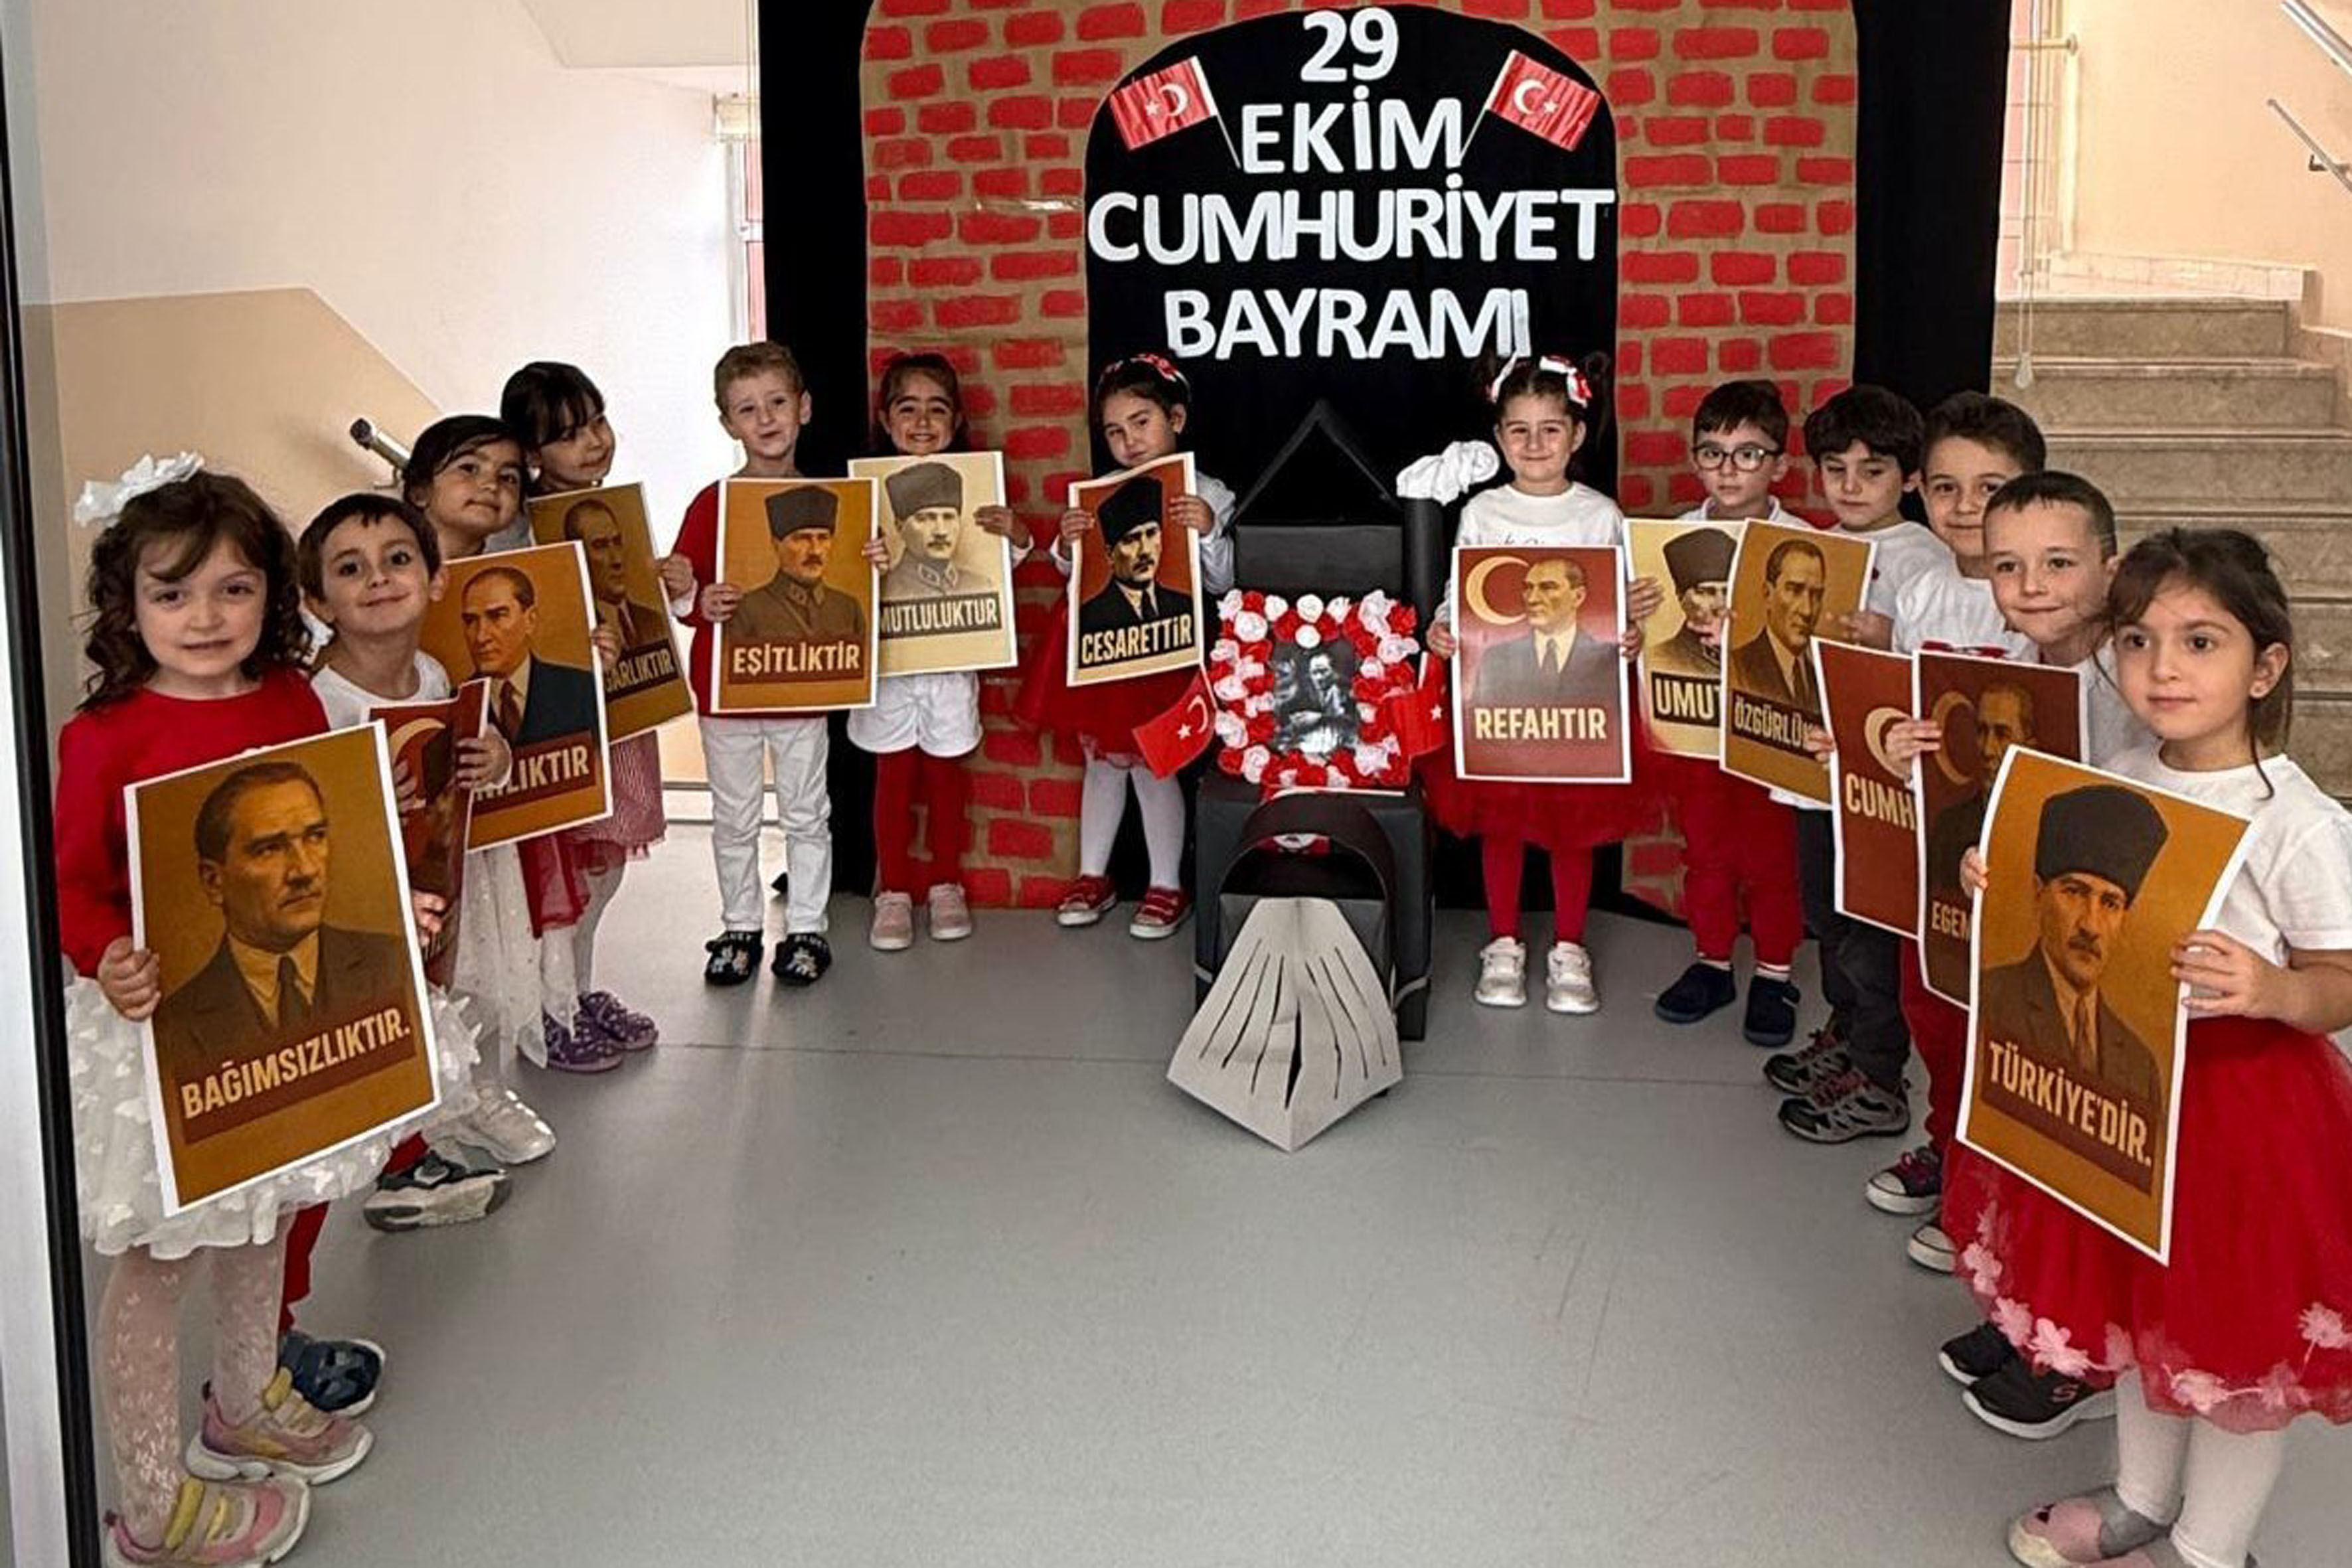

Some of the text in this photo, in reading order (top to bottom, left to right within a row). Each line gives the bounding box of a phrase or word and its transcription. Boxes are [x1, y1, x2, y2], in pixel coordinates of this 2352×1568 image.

[1300, 7, 1399, 83] 29
[1241, 85, 1462, 174] EKİM
[1087, 174, 1615, 266] CUMHURİYET
[1164, 287, 1532, 360] BAYRAMI
[733, 640, 860, 676] EŞİTLİKTİR
[1081, 613, 1192, 665] CESARETTİR
[1474, 707, 1607, 740] REFAHTIR
[1654, 678, 1721, 720] UMU
[1845, 771, 1916, 831] CUMH
[181, 1008, 412, 1119] BAĞIMSIZLIKTIR.
[1989, 1040, 2152, 1167] TÜRKİYE'DİR.
